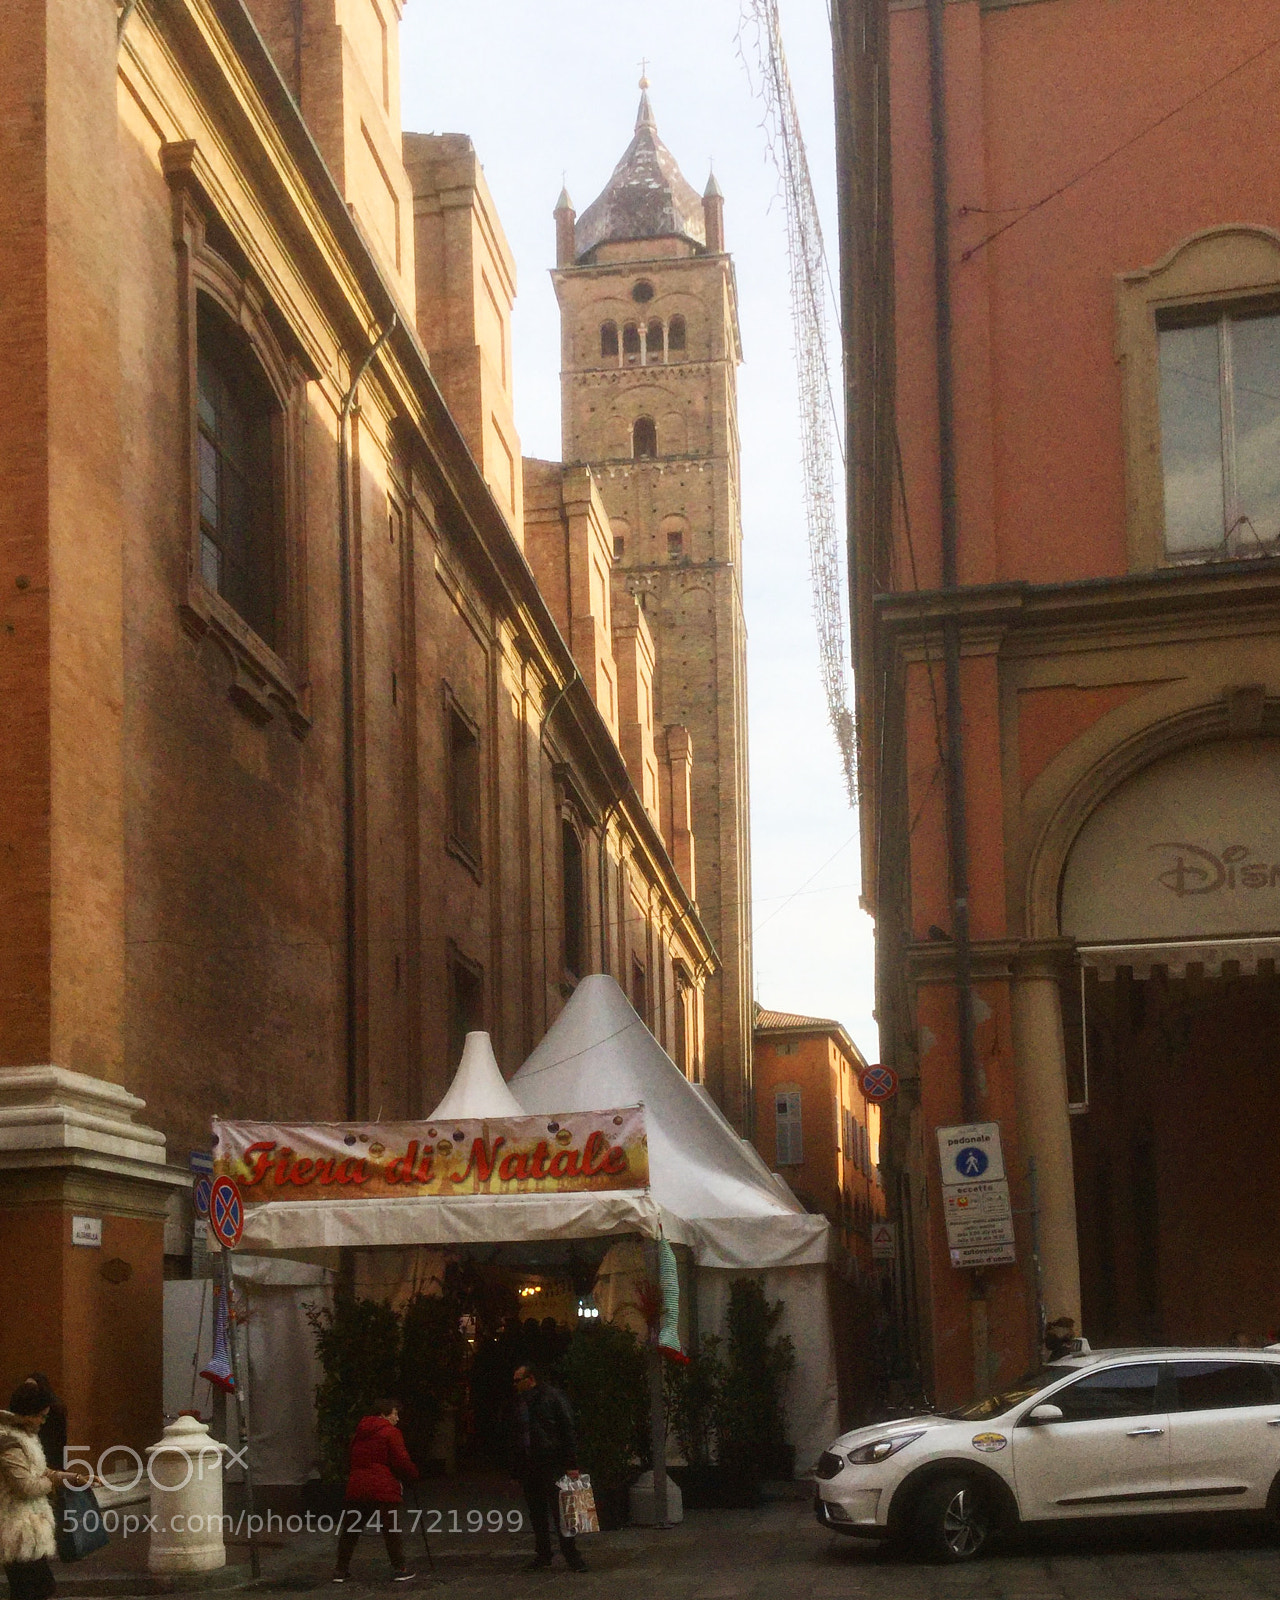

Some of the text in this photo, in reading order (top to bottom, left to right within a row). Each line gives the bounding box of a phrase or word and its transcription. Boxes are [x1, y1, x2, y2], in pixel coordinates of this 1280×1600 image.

[948, 1135, 991, 1146] pedonale
[238, 1130, 627, 1186] Fiera di Natale
[957, 1185, 993, 1194] eccetto
